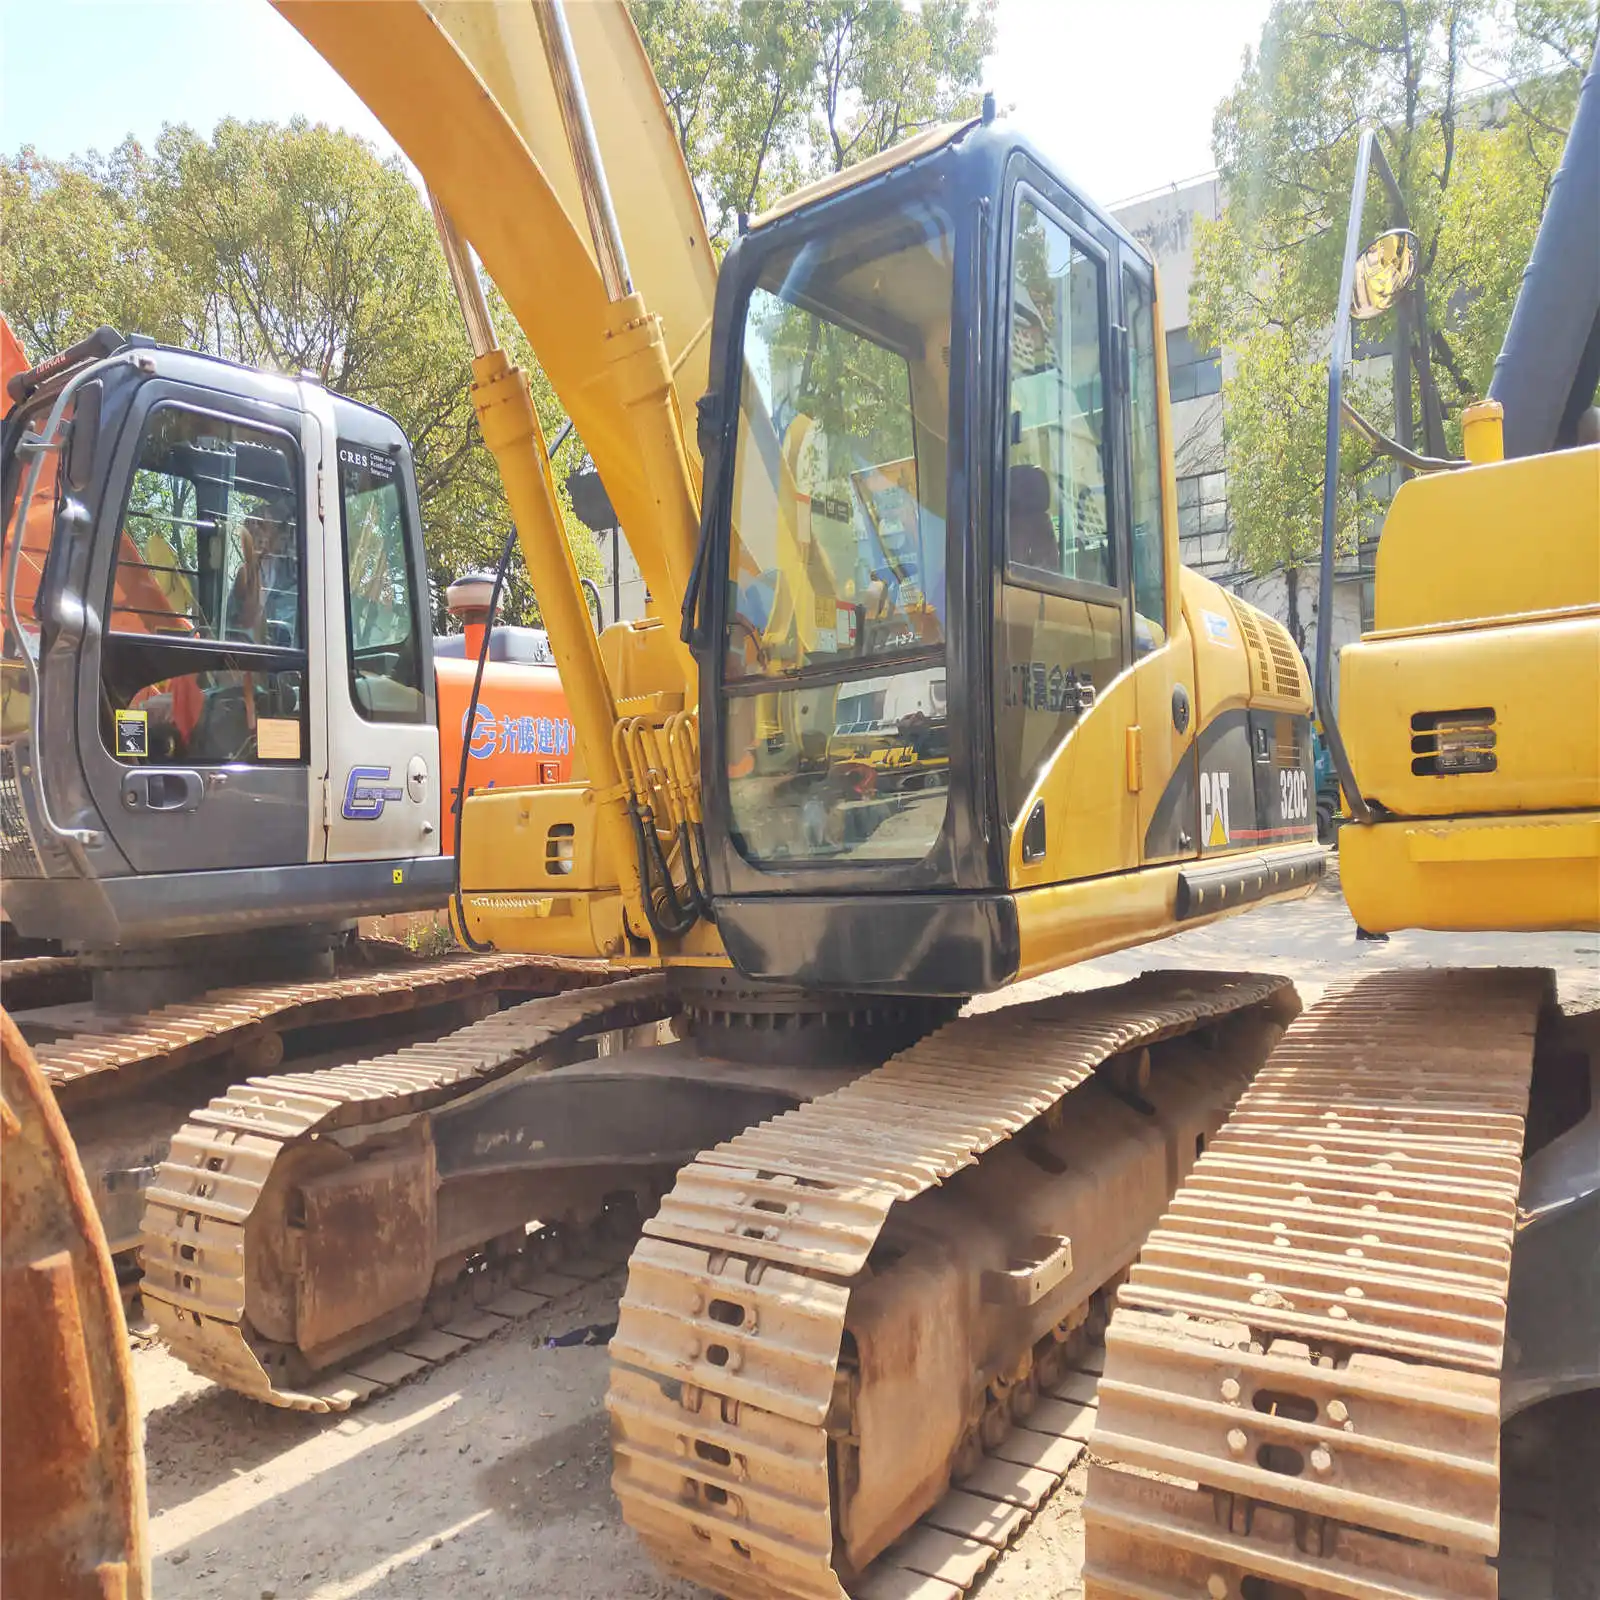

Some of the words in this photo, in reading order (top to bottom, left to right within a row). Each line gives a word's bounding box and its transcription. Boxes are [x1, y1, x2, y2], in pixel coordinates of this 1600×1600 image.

[340, 449, 368, 467] CRES
[1200, 771, 1230, 847] CAT
[1280, 769, 1308, 819] 320C
